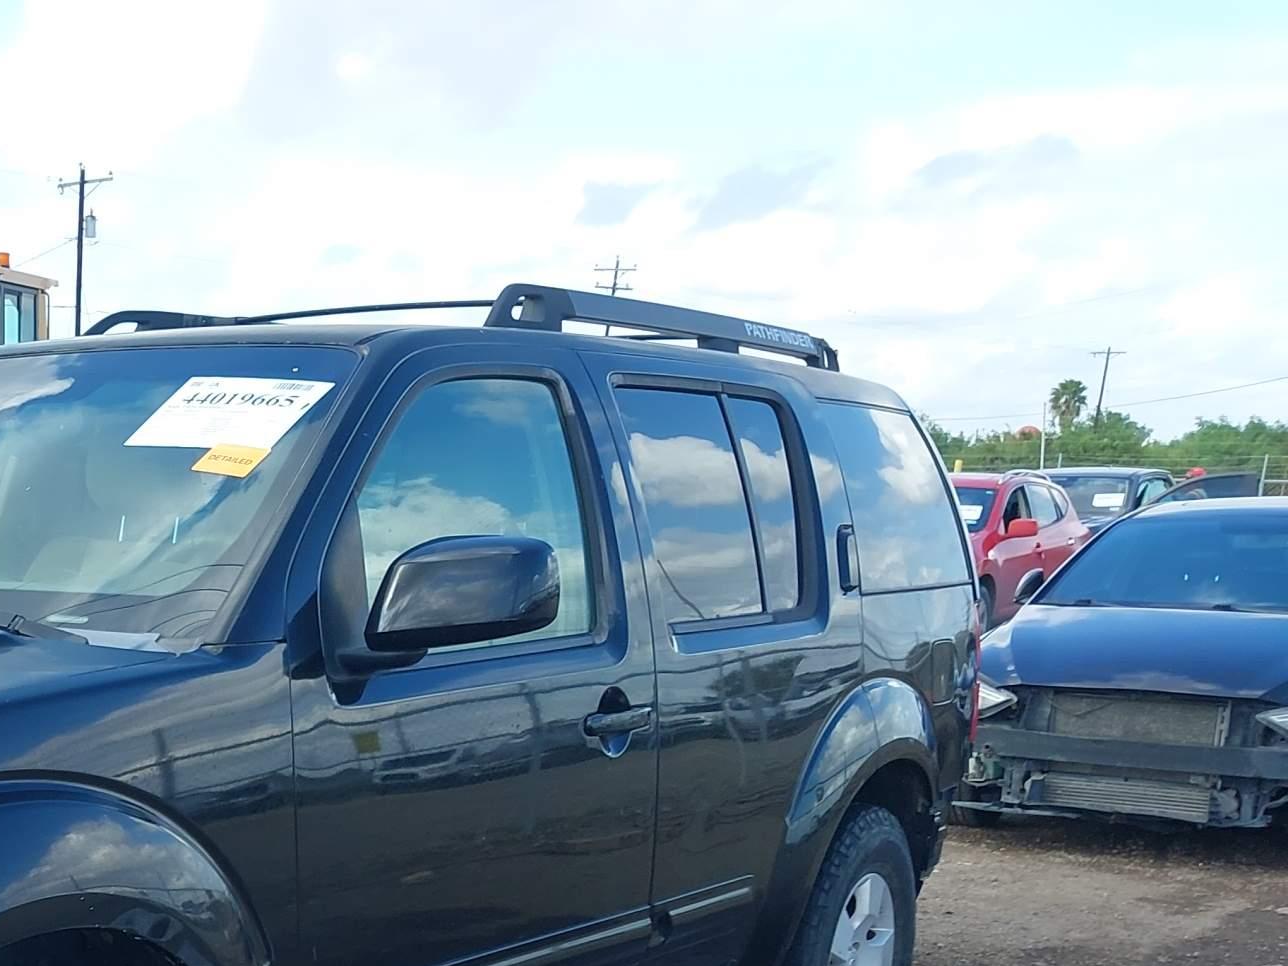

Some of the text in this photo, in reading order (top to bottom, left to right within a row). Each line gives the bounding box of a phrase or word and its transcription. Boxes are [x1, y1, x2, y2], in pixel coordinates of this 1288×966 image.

[743, 322, 814, 349] PATHFINDER
[183, 392, 301, 408] 44019665
[208, 454, 253, 466] DETAILED
